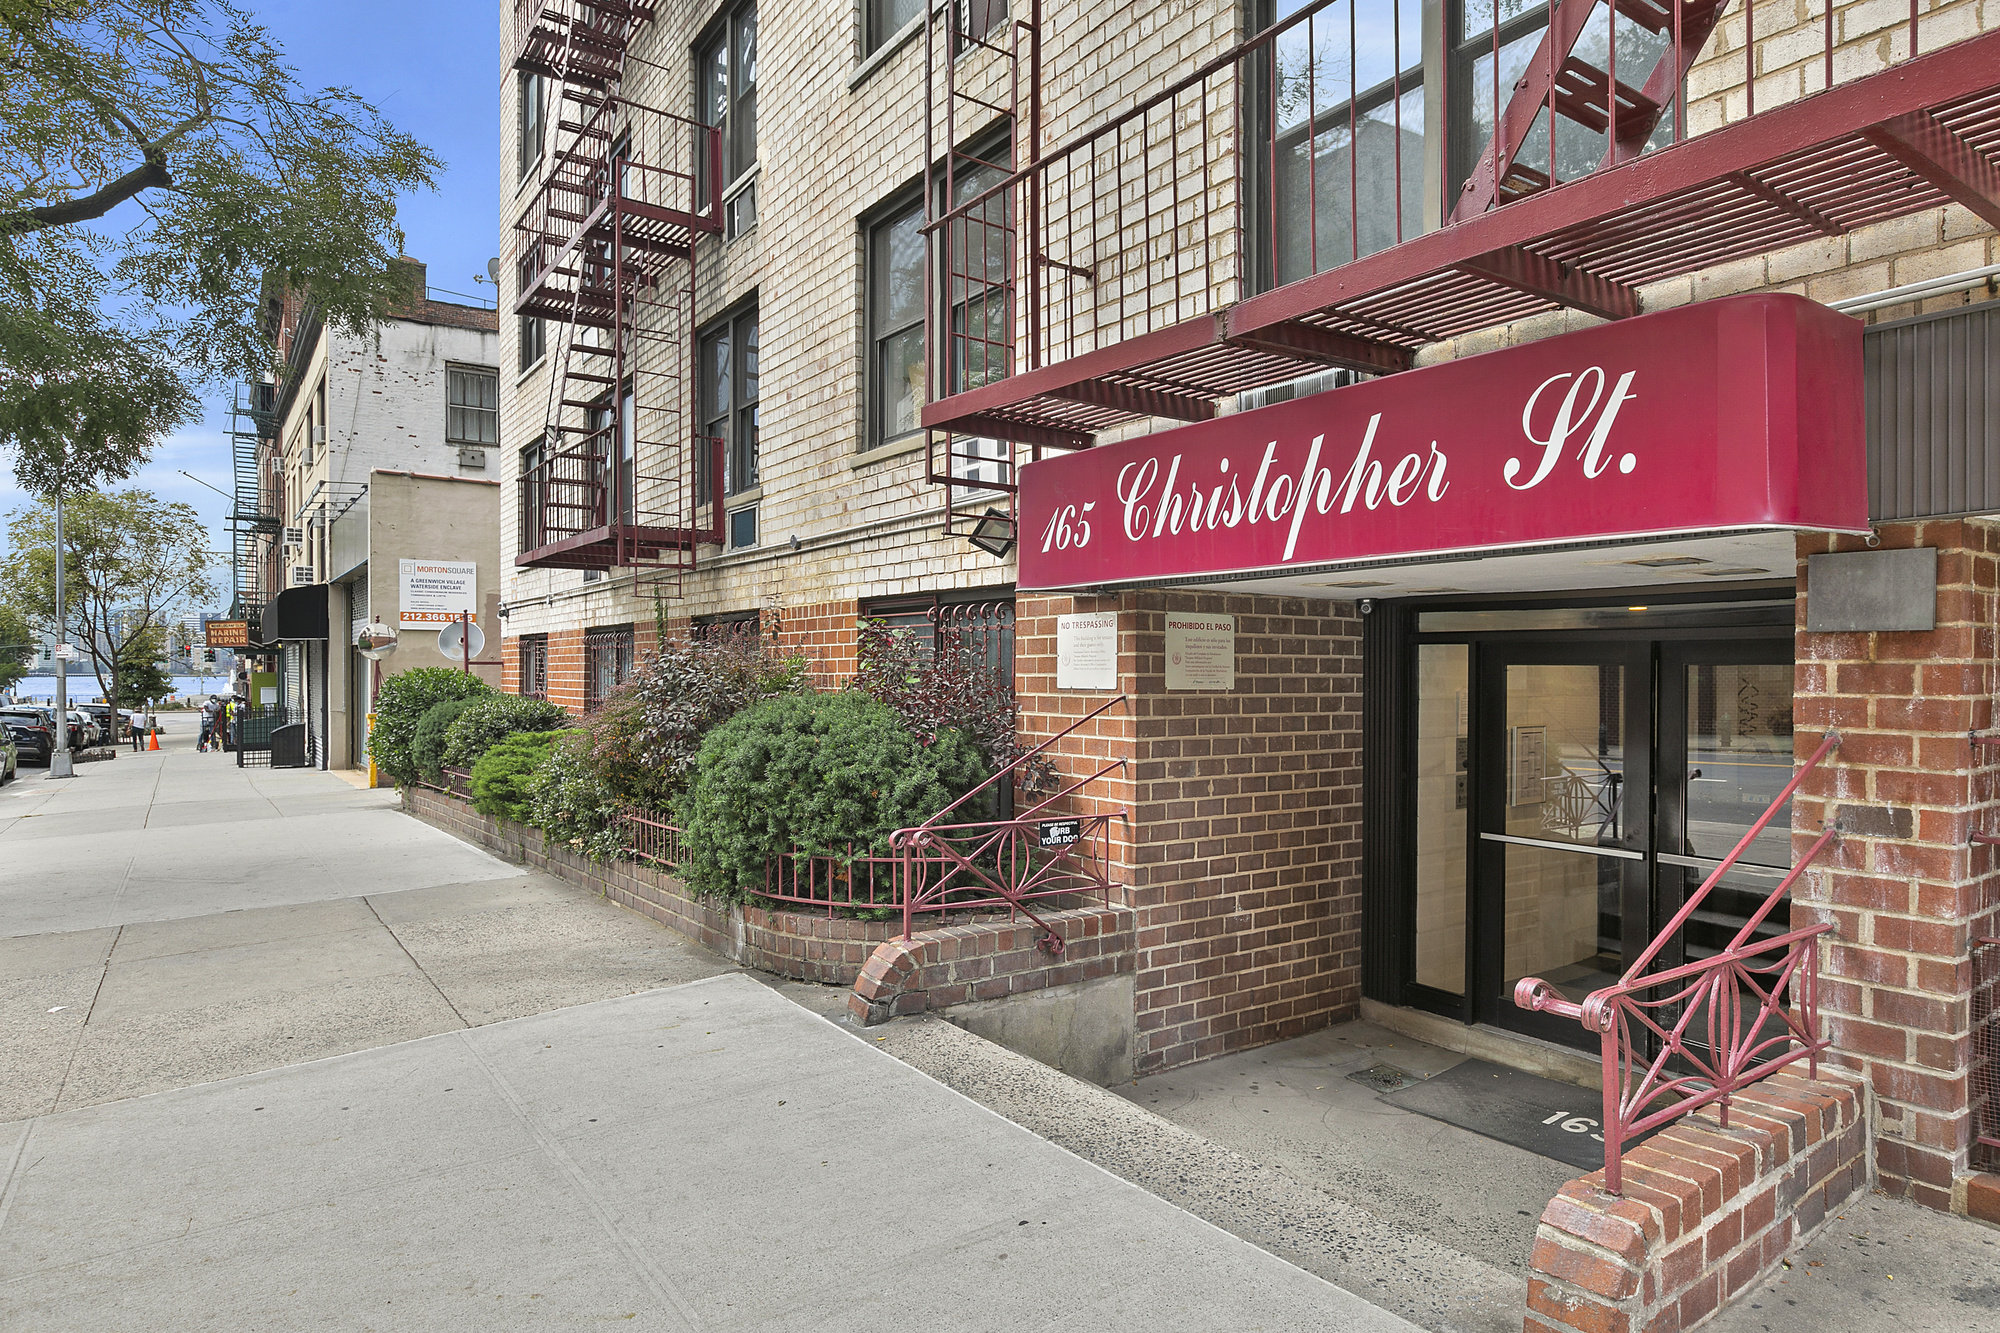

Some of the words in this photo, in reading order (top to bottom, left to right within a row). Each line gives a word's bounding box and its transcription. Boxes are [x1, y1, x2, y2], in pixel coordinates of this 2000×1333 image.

[1041, 500, 1096, 553] 165
[1116, 412, 1450, 562] Christopher
[1503, 366, 1637, 491] St.
[402, 613, 473, 621] 212.366.155
[1061, 622, 1070, 630] NO
[1072, 619, 1114, 629] TRESPASSING
[1168, 621, 1205, 630] PROHIBIDO
[1206, 622, 1213, 631] EL
[1215, 623, 1232, 632] PASO
[210, 629, 246, 637] MARINE
[210, 636, 246, 644] REPAIR
[1041, 836, 1061, 845] YOUR
